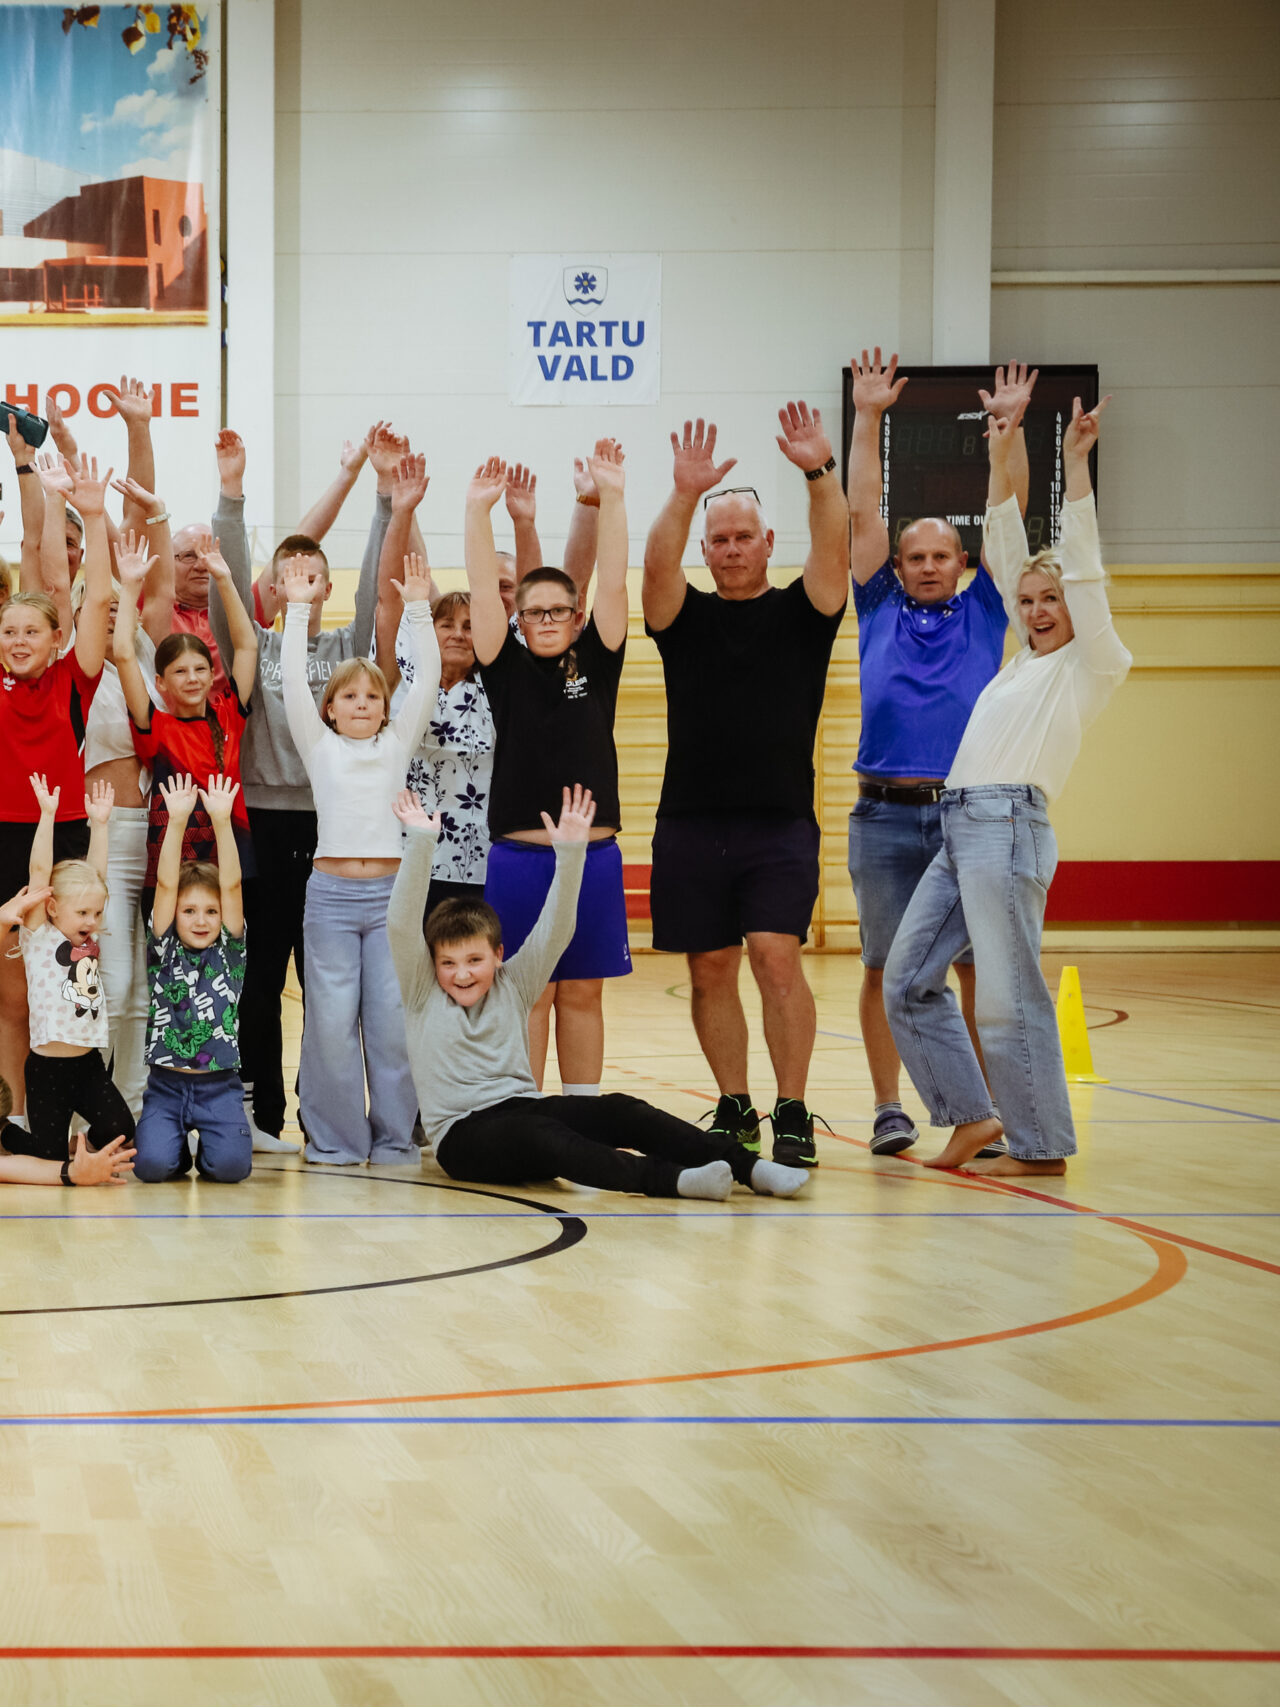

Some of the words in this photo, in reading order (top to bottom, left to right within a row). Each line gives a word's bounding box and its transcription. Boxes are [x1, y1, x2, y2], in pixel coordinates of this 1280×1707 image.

[527, 321, 645, 347] TARTU
[537, 355, 634, 381] VALD
[1055, 411, 1061, 423] 4
[1055, 424, 1061, 435] 5
[1055, 435, 1061, 447] 6
[1055, 447, 1061, 458] 7
[1055, 458, 1061, 469] 8
[1055, 470, 1061, 481] 9
[1050, 481, 1061, 493] 10
[1050, 493, 1060, 504] 11
[1050, 504, 1061, 515] 12
[946, 515, 971, 526] TIME
